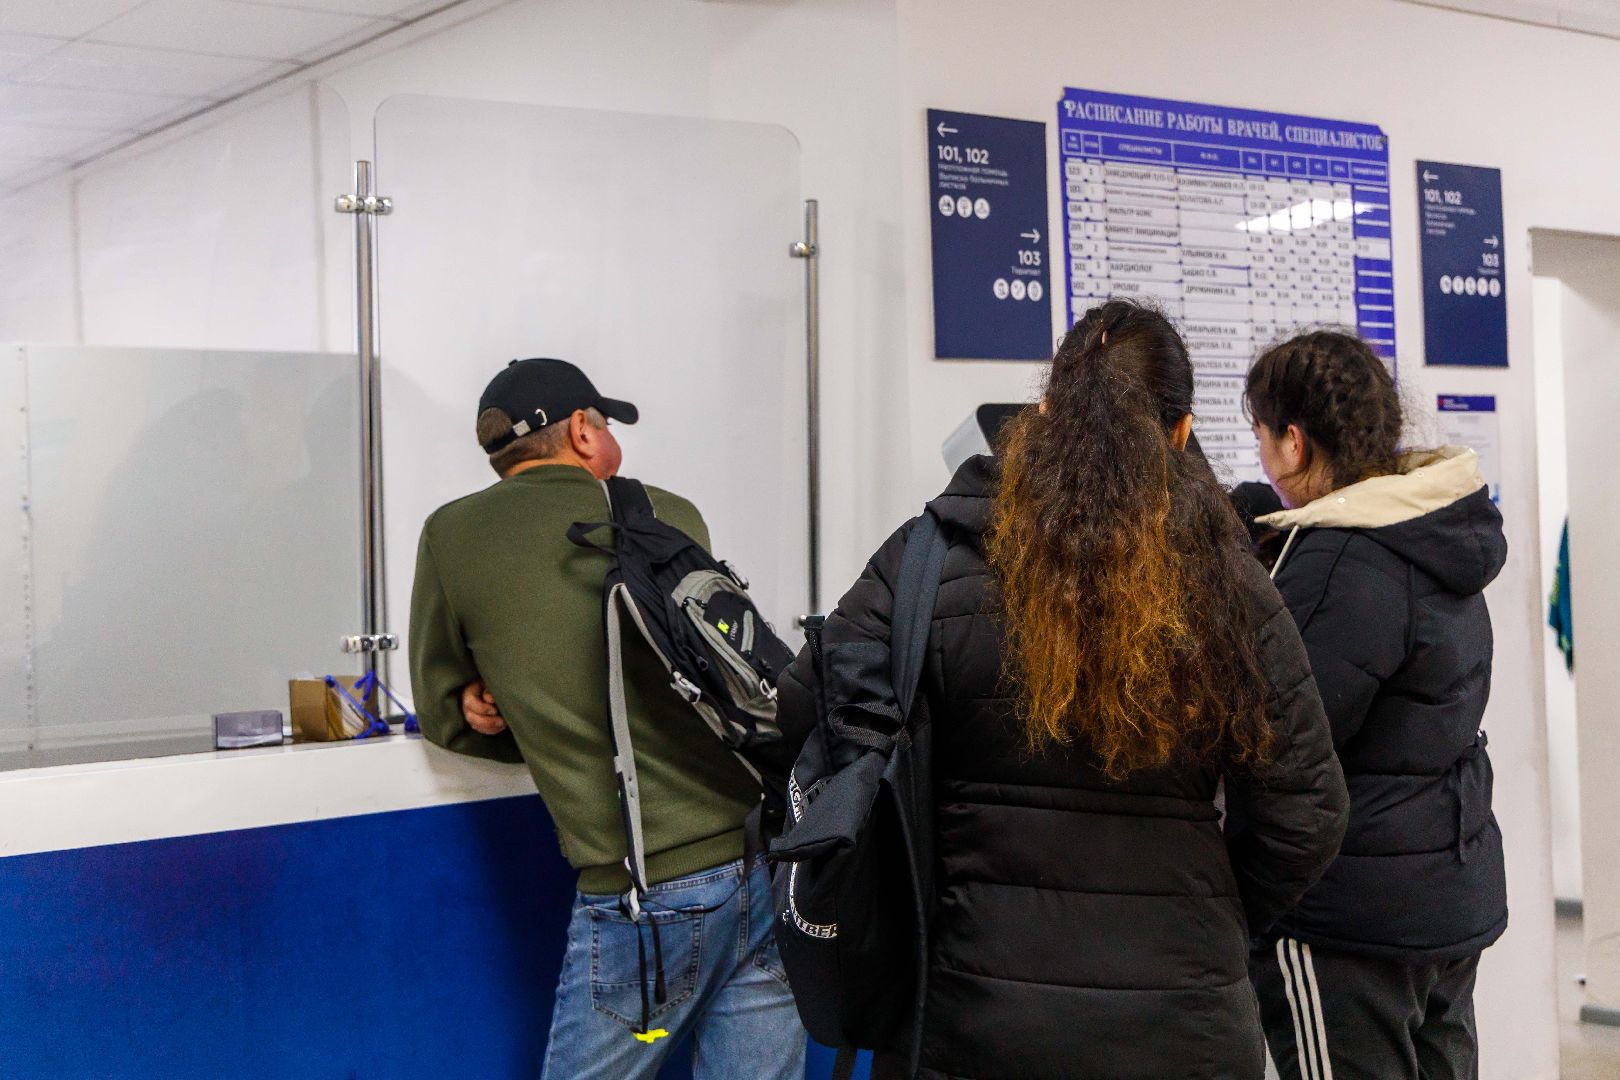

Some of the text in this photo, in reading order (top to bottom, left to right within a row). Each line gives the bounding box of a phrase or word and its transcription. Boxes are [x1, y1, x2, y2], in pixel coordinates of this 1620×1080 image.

[1066, 101, 1164, 128] РАСПИСАНИЕ
[1167, 112, 1223, 134] РАБОТЫ
[938, 145, 990, 165] 101, 102
[1018, 250, 1041, 266] 103
